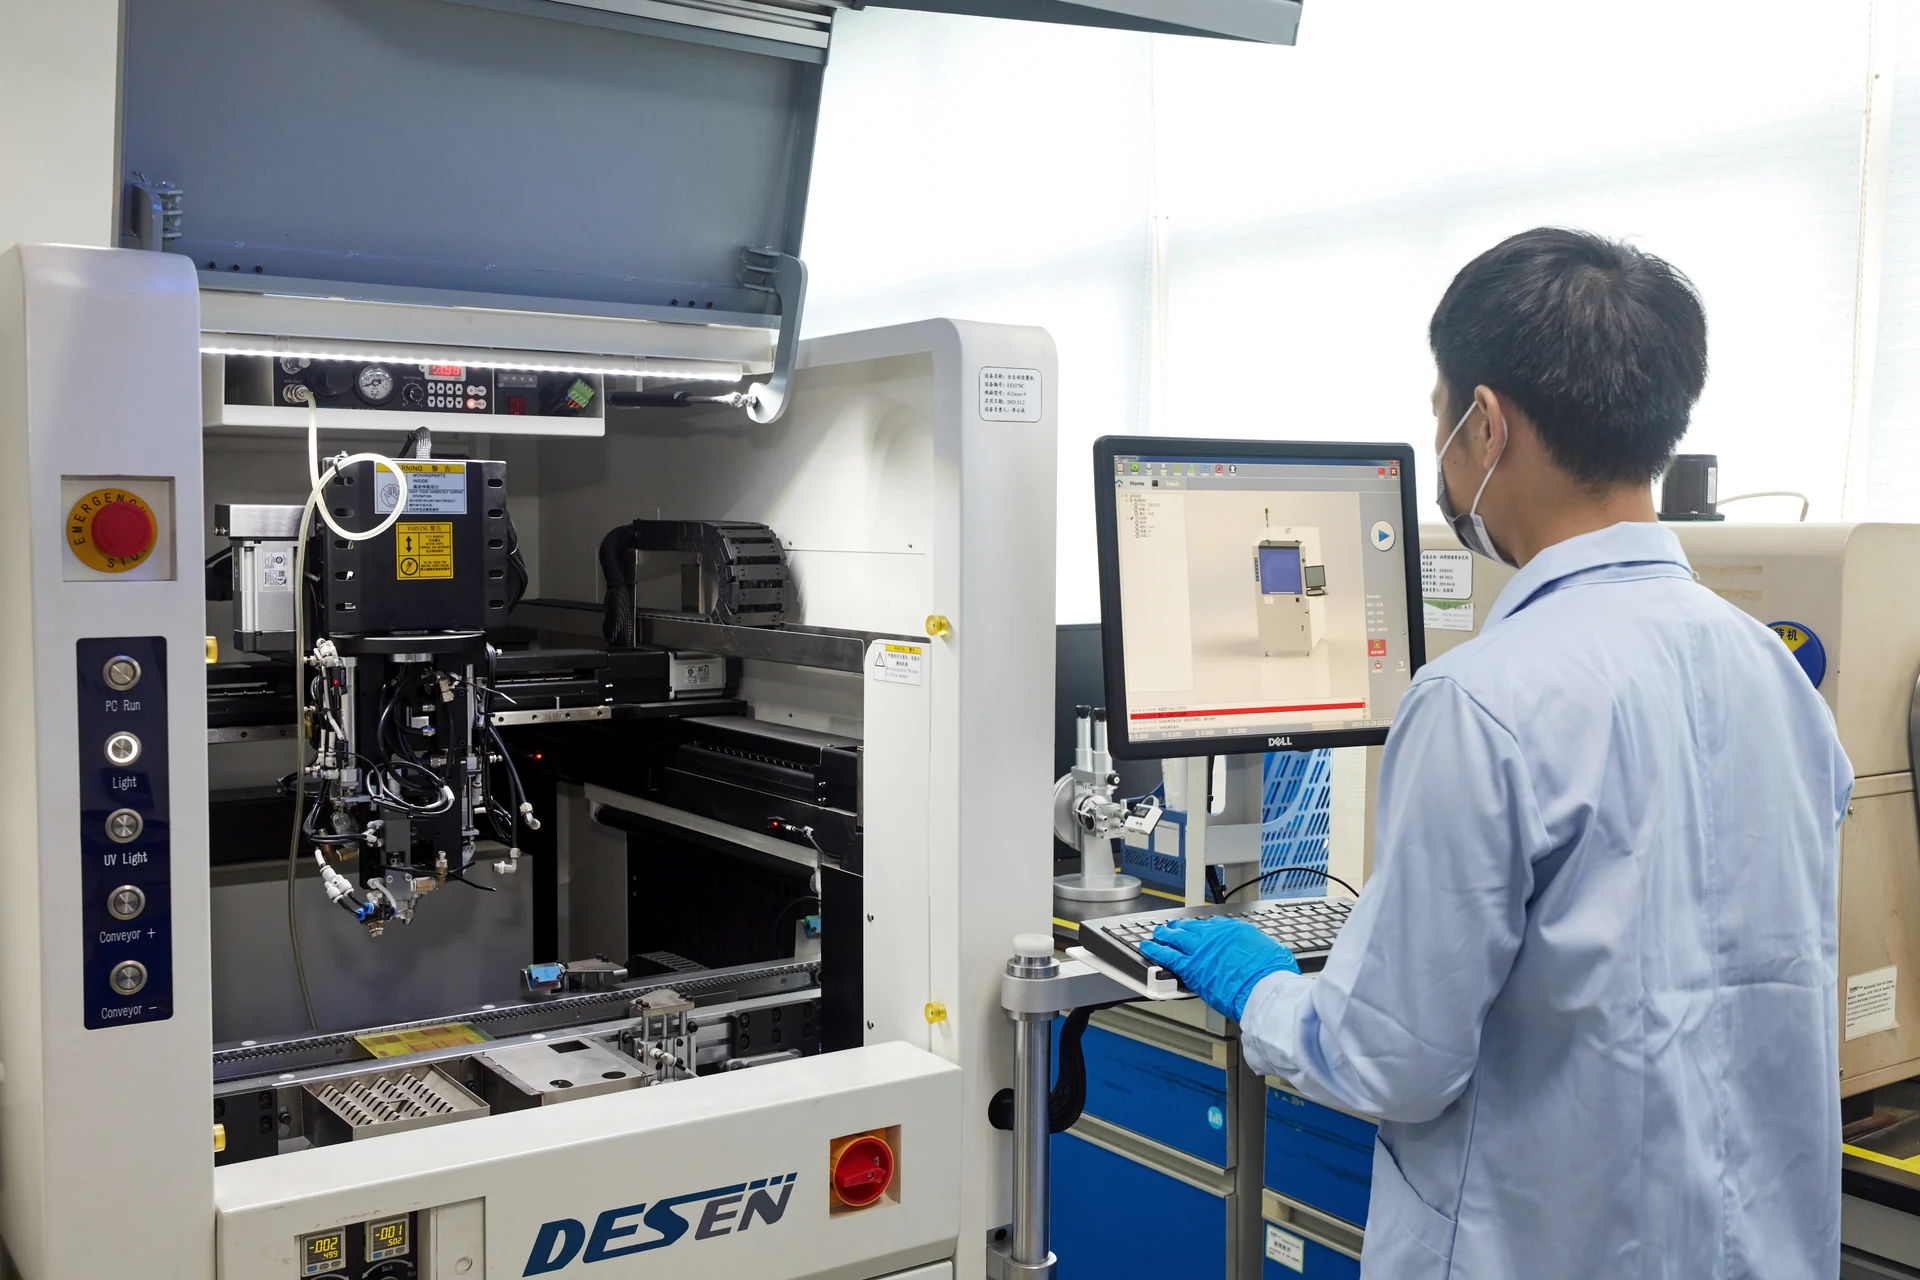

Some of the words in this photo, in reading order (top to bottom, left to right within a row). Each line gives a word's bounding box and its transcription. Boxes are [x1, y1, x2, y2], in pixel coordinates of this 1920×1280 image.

[1774, 628, 1798, 641] 待机
[105, 700, 117, 712] PC
[123, 700, 141, 711] Run
[1268, 737, 1292, 746] DELL
[112, 776, 137, 790] Light
[104, 854, 116, 866] UV
[122, 852, 148, 866] Light
[100, 930, 141, 943] Conveyor
[101, 1005, 142, 1019] Conveyor
[522, 1172, 798, 1278] DESEN
